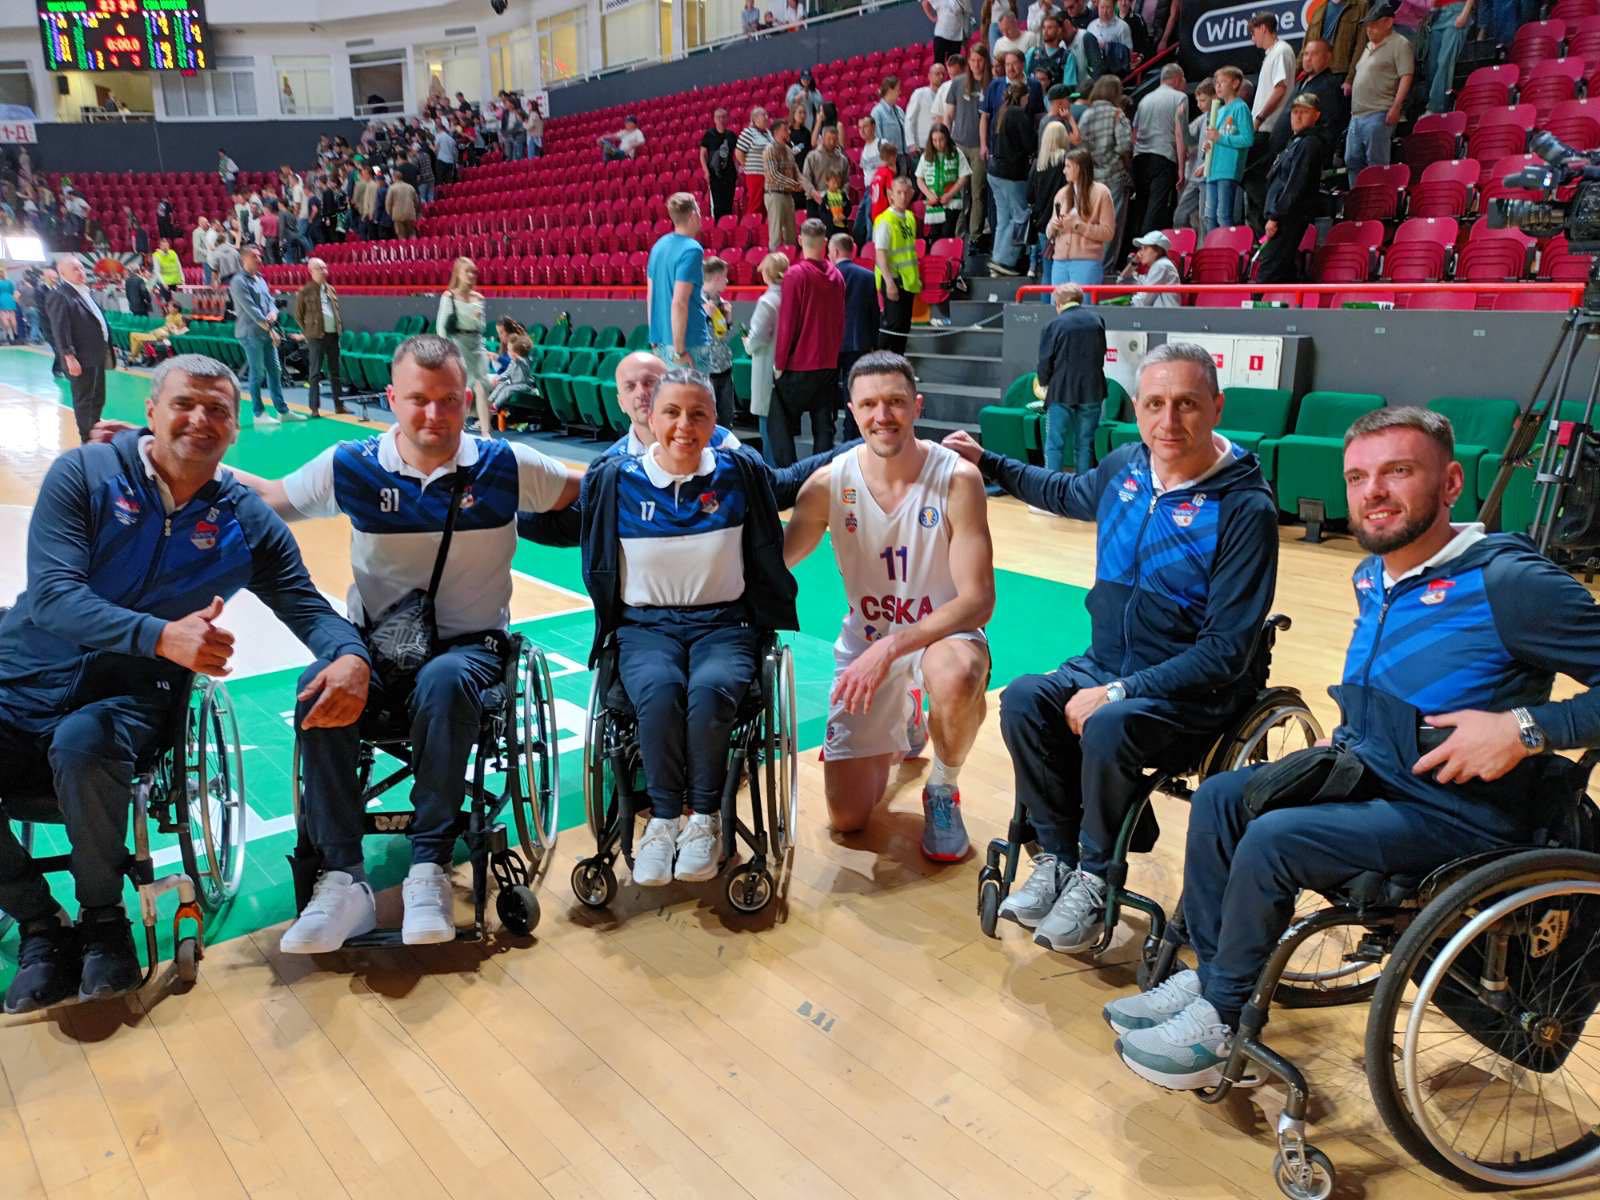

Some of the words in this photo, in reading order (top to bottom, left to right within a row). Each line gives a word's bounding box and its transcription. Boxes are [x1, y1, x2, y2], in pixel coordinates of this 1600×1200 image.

[1205, 10, 1296, 43] Wine
[380, 487, 400, 512] 31
[640, 501, 655, 521] 17
[879, 546, 908, 583] 11
[860, 594, 934, 625] CSKA
